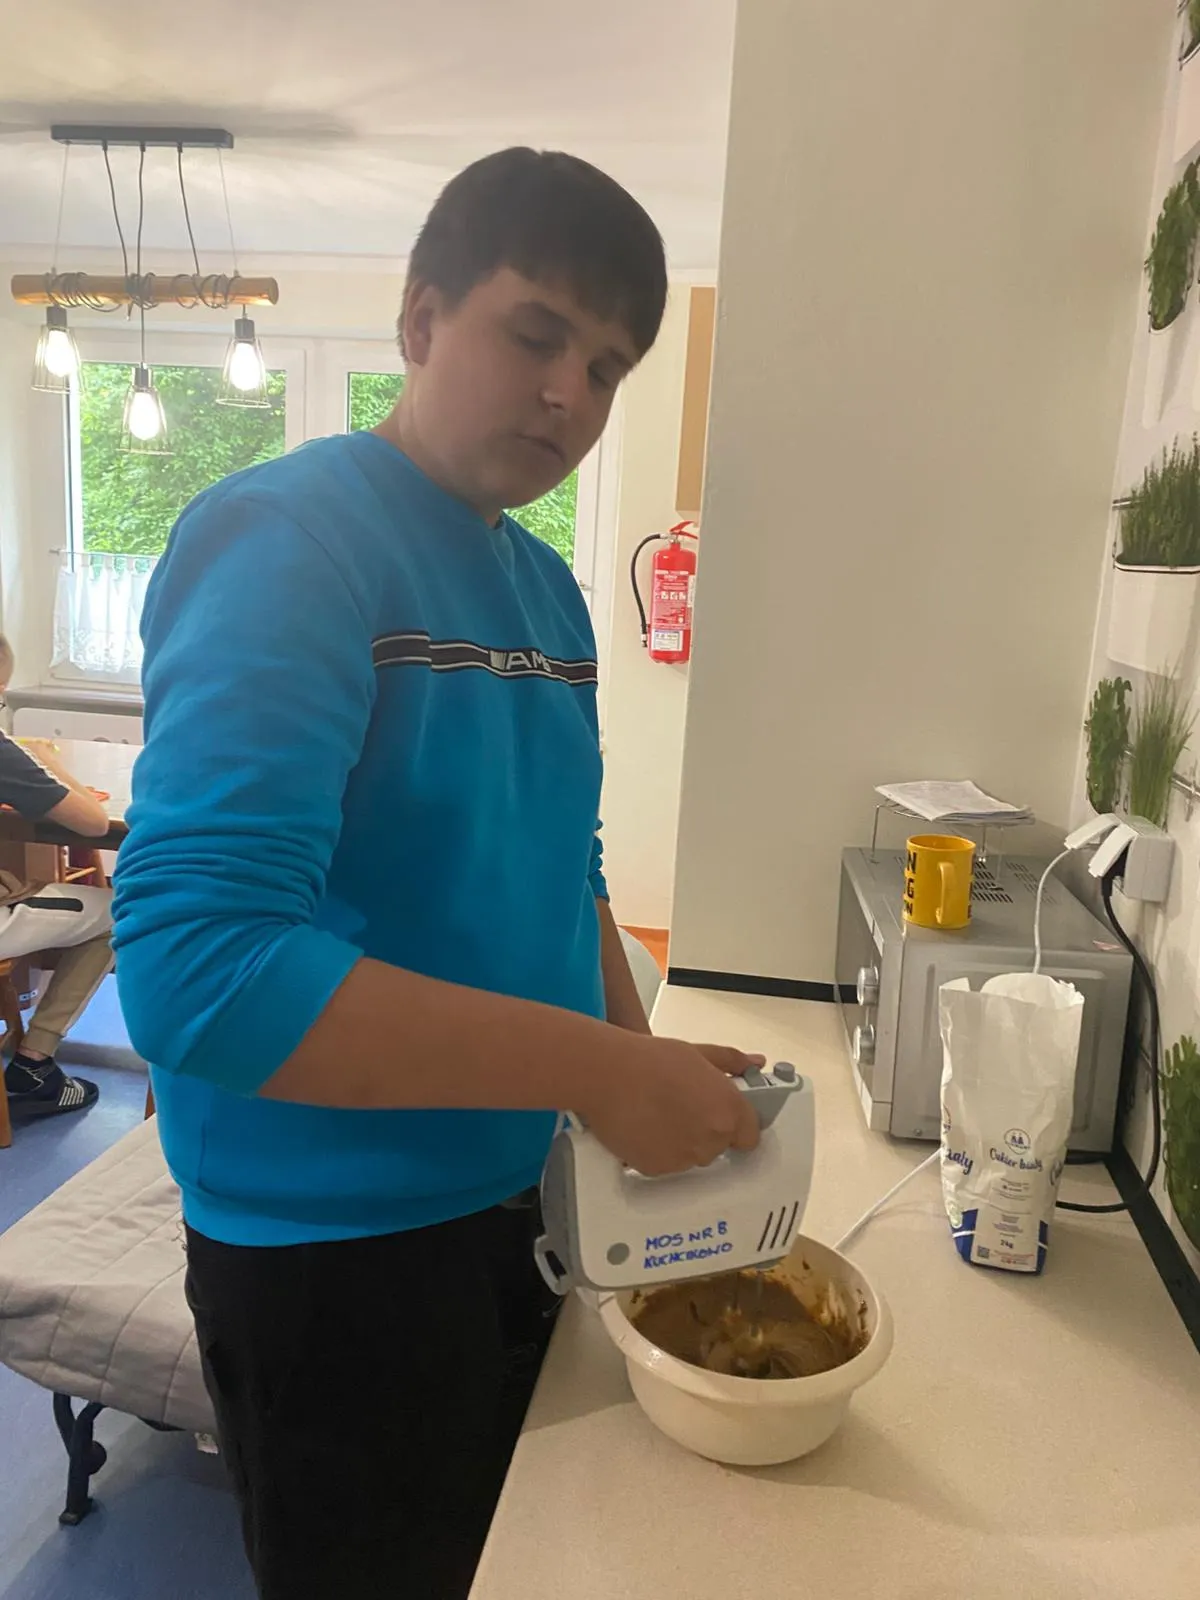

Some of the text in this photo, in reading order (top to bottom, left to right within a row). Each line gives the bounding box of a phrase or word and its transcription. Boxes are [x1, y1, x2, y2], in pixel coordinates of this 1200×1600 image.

[989, 1147, 1018, 1168] Cukier
[645, 1233, 684, 1251] MOS
[688, 1226, 713, 1242] NR
